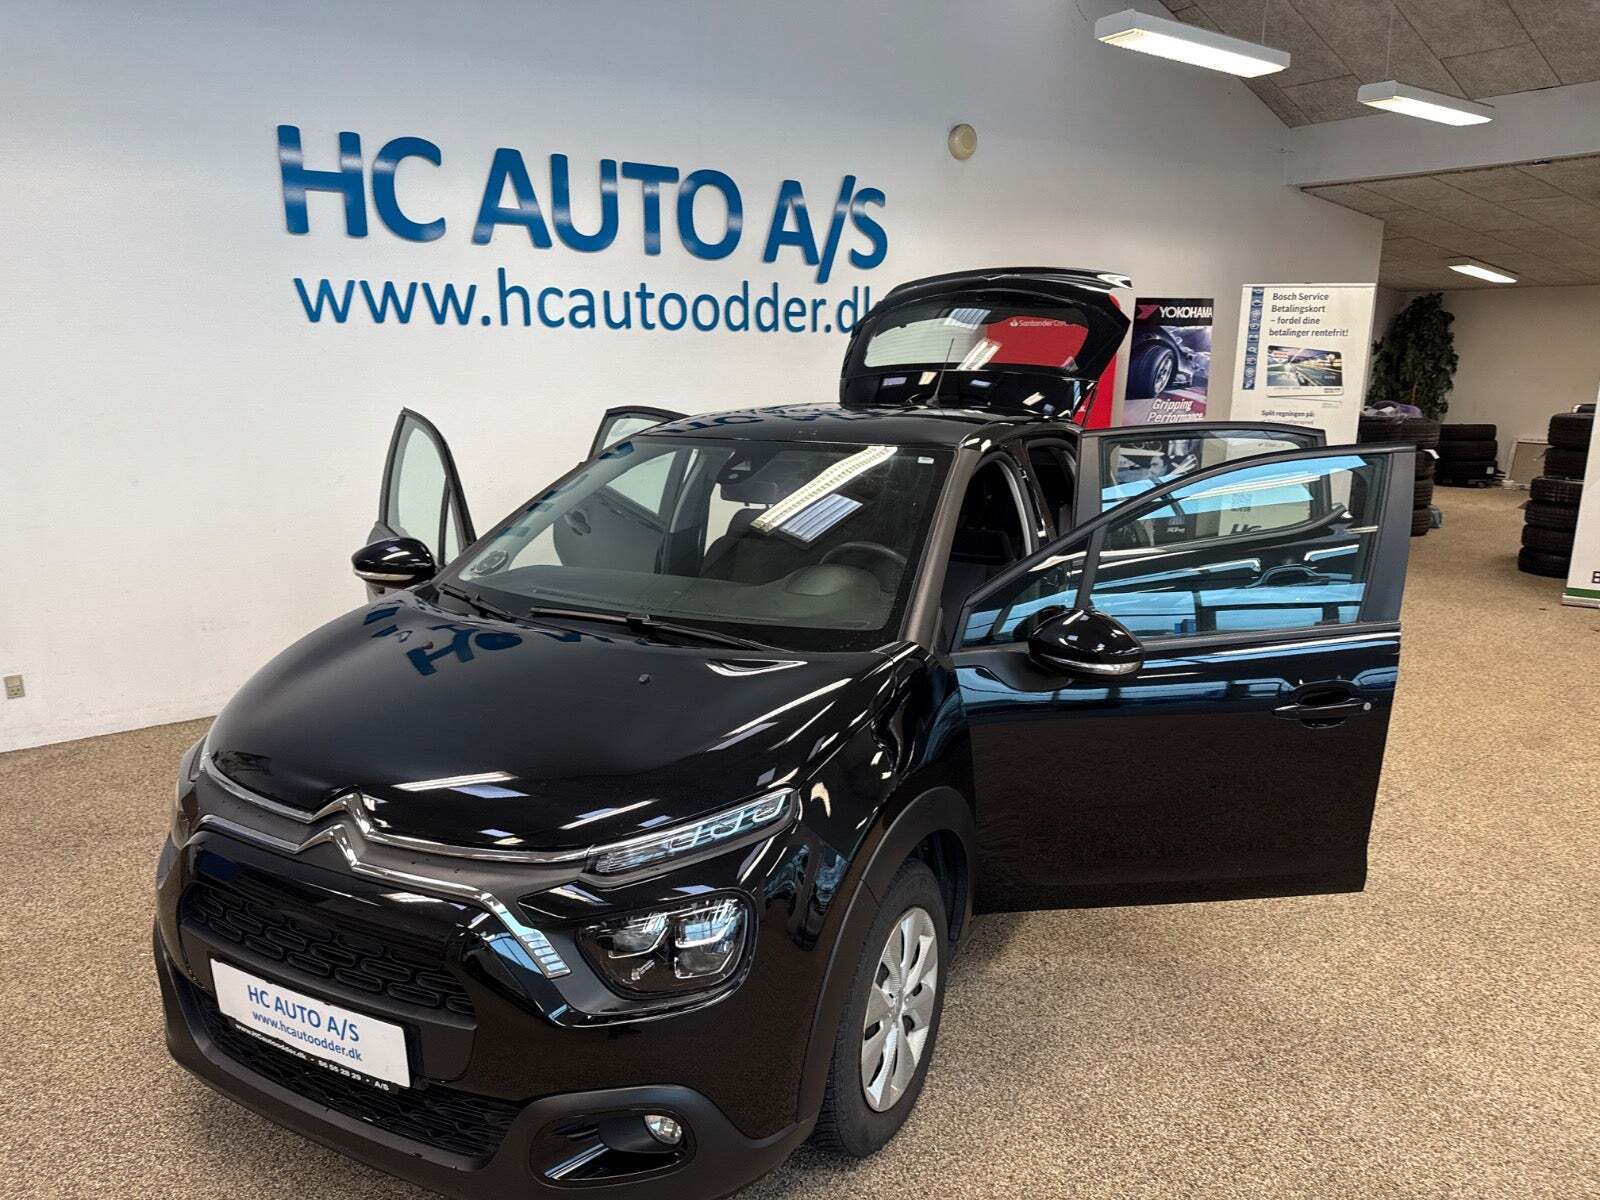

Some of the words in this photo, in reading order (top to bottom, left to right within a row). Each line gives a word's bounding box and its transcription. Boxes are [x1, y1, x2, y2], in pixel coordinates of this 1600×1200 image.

[277, 125, 446, 242] HC
[471, 148, 743, 261] AUTO
[763, 174, 889, 284] A/S
[1272, 292, 1297, 301] Bosch
[1298, 292, 1329, 301] Service
[1159, 306, 1213, 319] YOKOHAMA
[1271, 304, 1326, 314] Betalingskort
[1277, 315, 1301, 325] fordel
[1302, 315, 1321, 325] dine
[1268, 328, 1310, 338] betalinger
[1311, 328, 1349, 337] rentefrit!
[1152, 398, 1192, 412] Gripping
[1147, 411, 1204, 423] Performance
[247, 985, 271, 1009] HC
[274, 997, 321, 1029] AUTO
[327, 1013, 360, 1042] A/S
[252, 1010, 363, 1062] www.hcautoodder.dk
